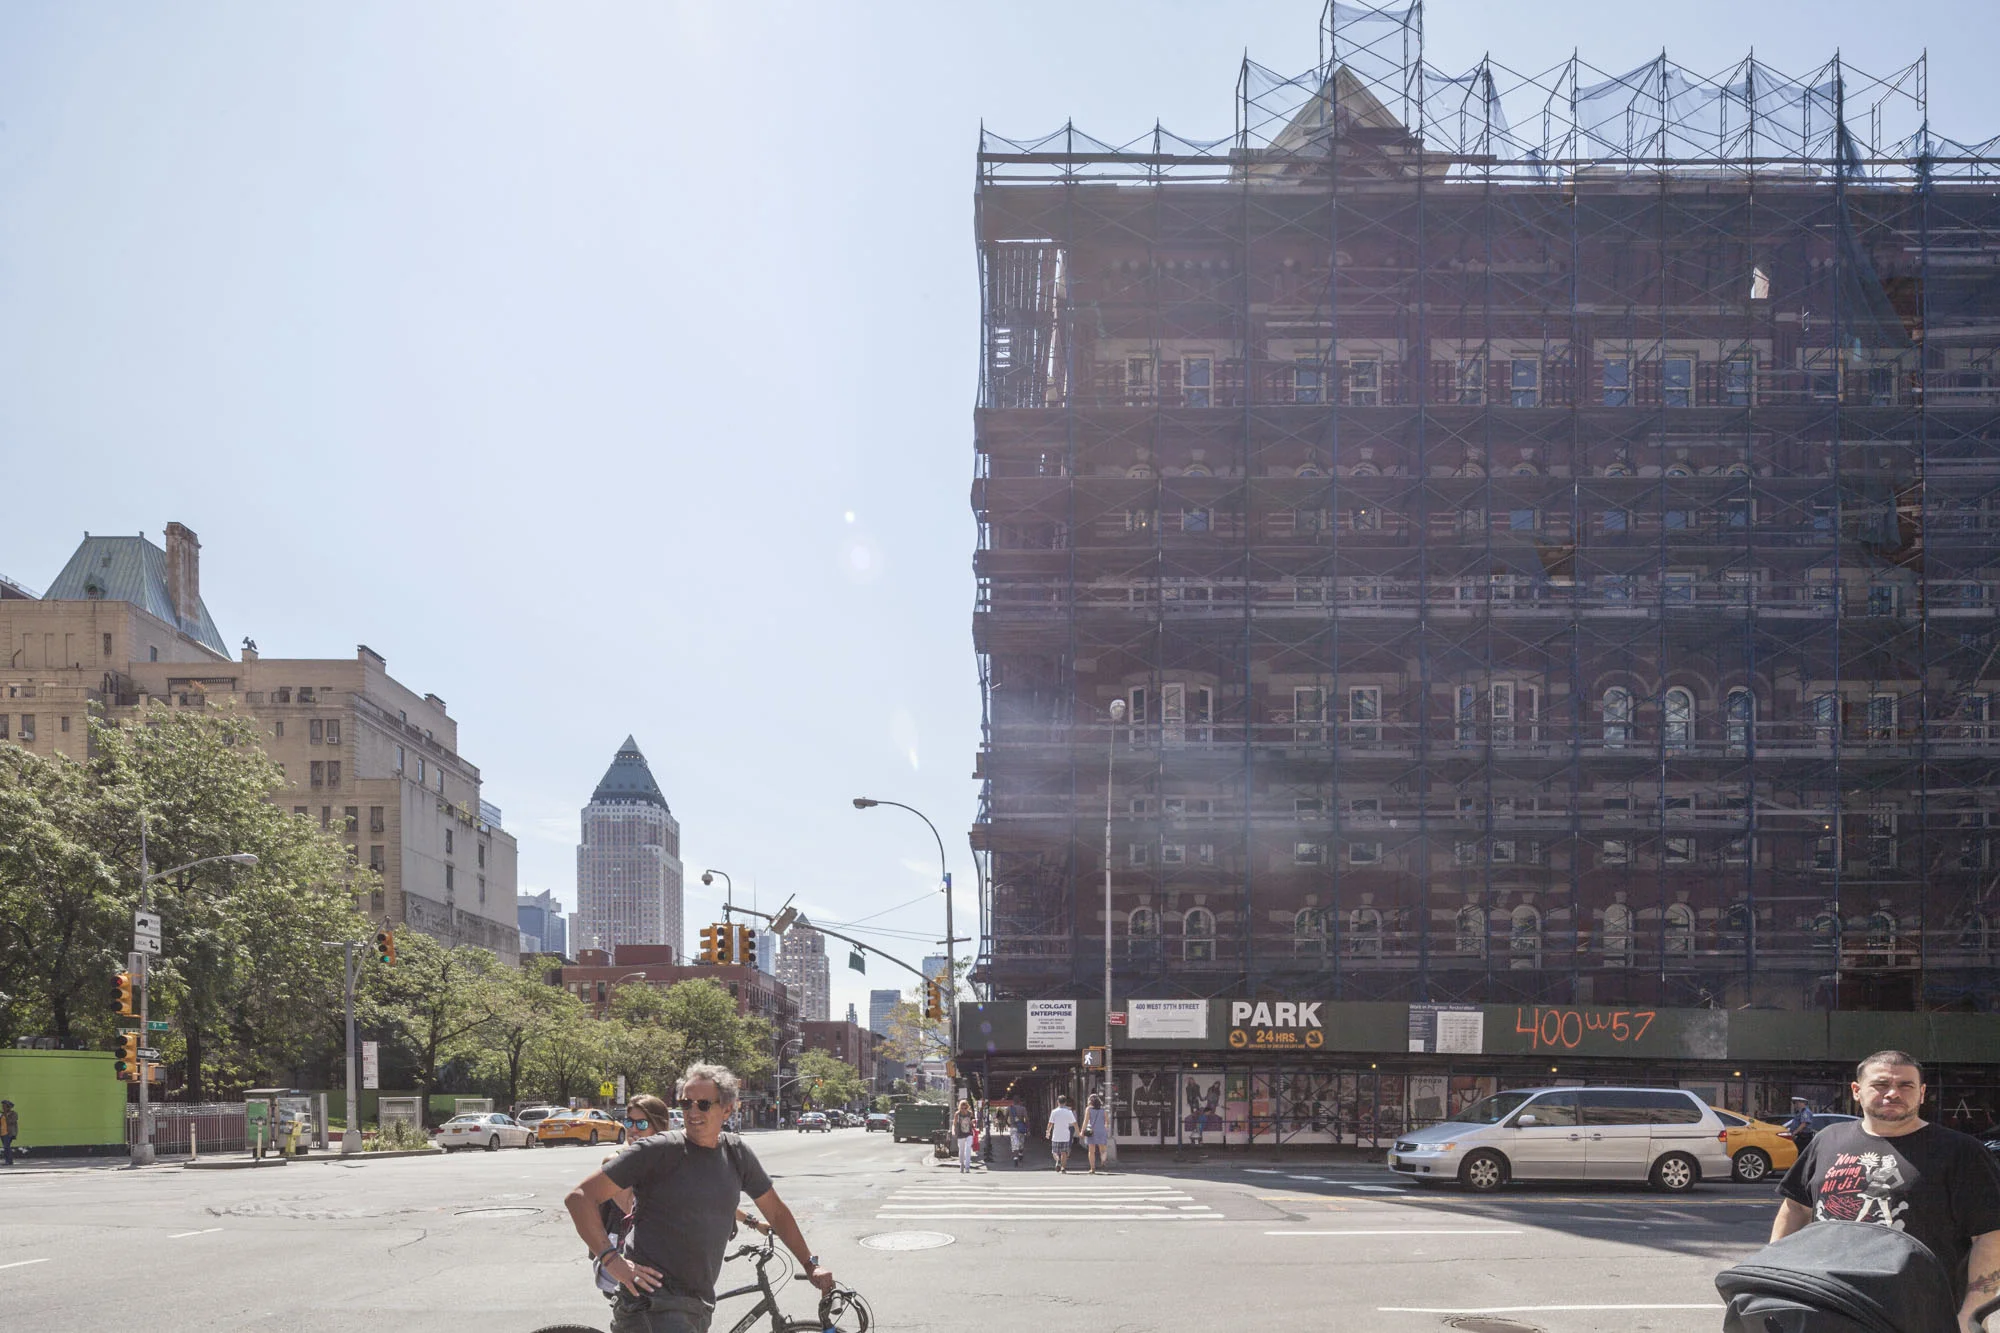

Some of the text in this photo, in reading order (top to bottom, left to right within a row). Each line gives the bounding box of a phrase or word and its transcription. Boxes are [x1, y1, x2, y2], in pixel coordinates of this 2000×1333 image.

[1232, 1001, 1322, 1027] PARK
[1256, 1029, 1298, 1043] 24 HRS.
[1411, 1076, 1442, 1084] Proenza
[1824, 1165, 1862, 1179] Serving
[1820, 1179, 1837, 1194] All
